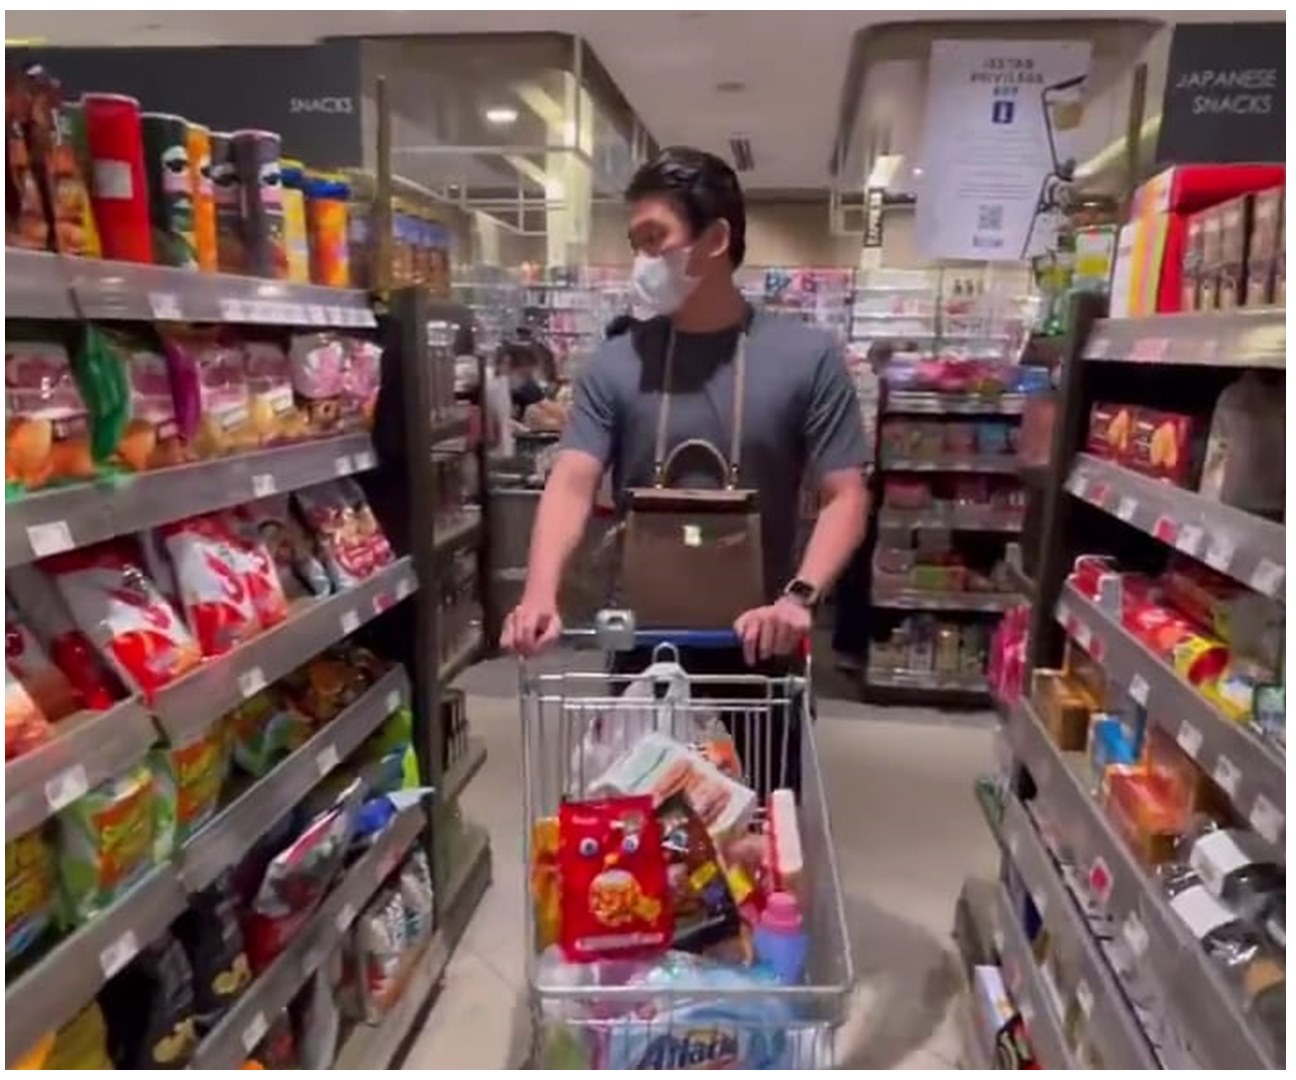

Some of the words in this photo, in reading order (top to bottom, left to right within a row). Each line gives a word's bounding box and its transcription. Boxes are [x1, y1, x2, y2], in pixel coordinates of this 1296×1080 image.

[1175, 68, 1277, 89] JAPANESE
[289, 96, 352, 114] SNACKS
[1192, 94, 1272, 115] SNACKS
